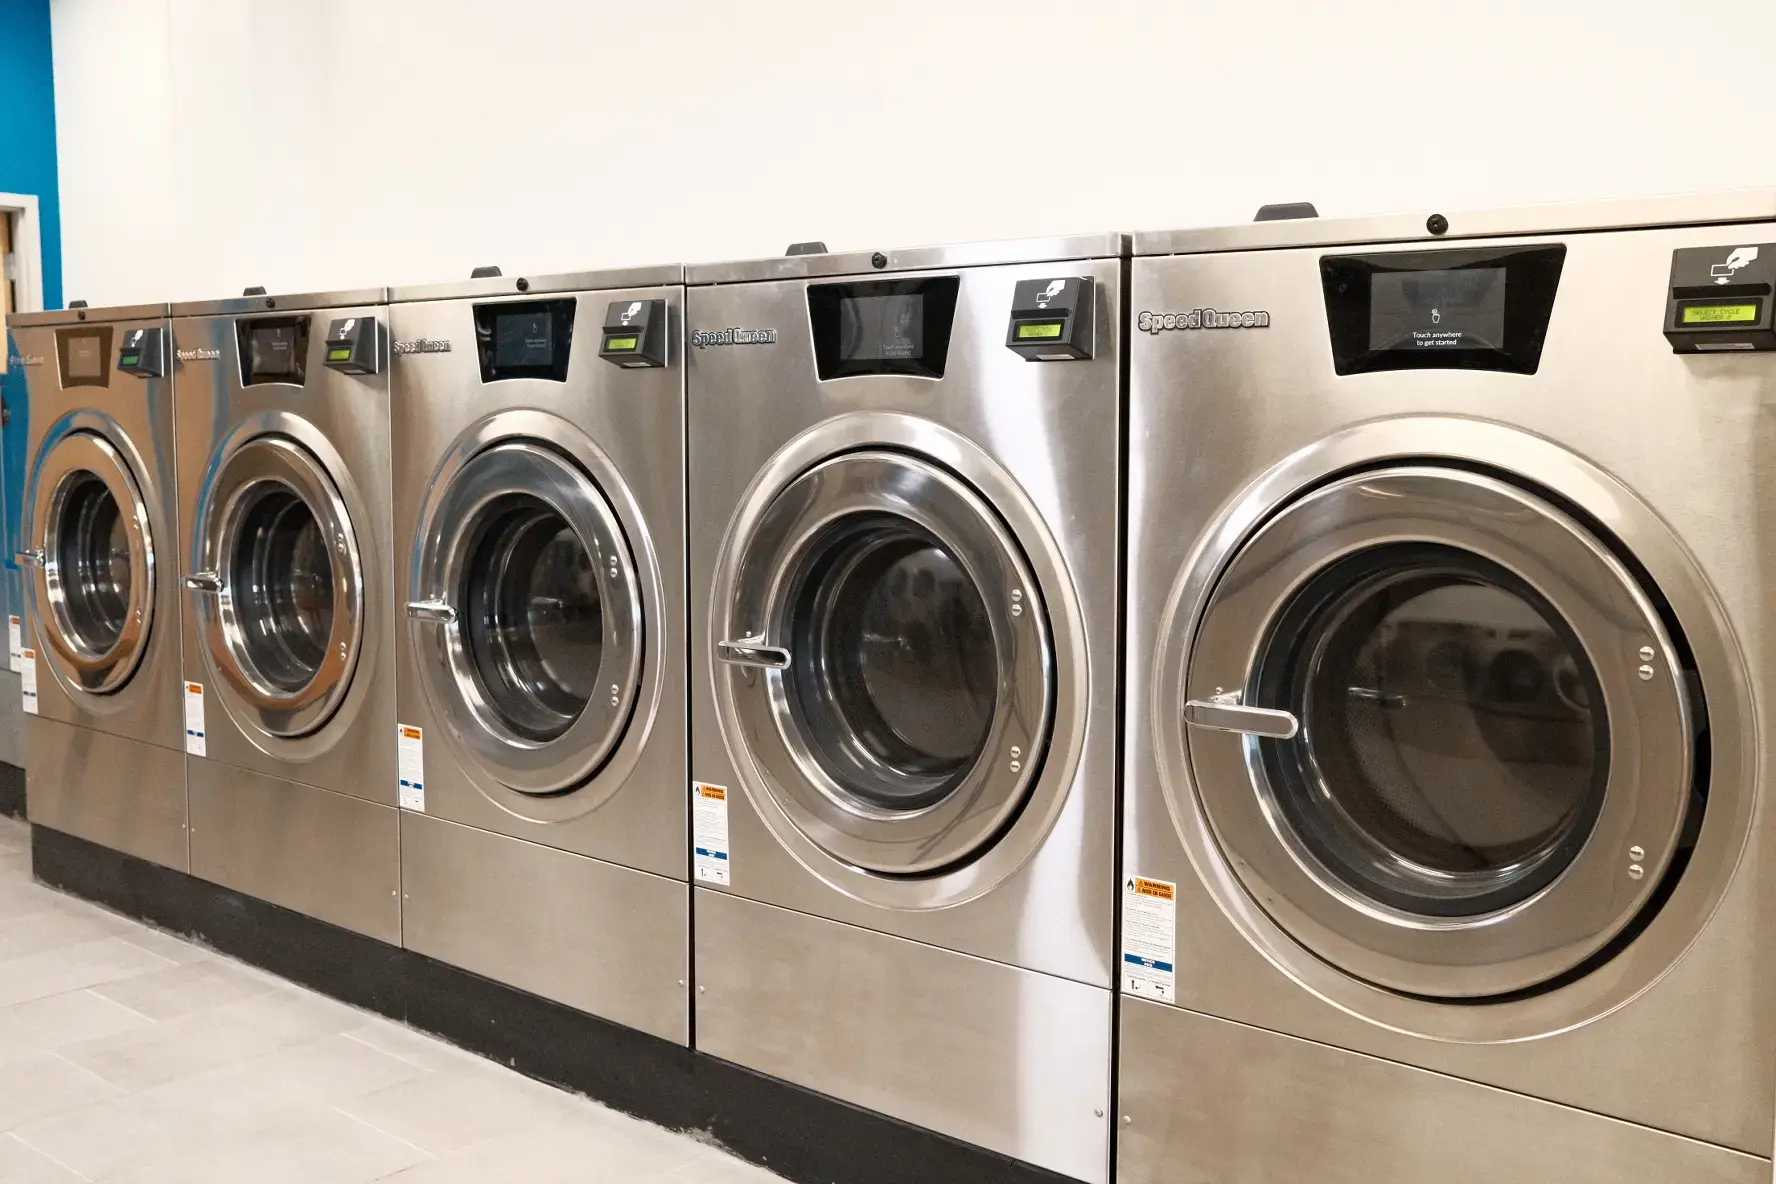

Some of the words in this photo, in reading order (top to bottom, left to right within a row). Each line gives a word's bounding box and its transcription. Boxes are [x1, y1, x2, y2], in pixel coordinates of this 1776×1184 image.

[1138, 309, 1202, 335] Speed
[1202, 308, 1270, 329] Queen
[692, 328, 733, 349] Speed
[733, 327, 777, 344] Queen
[1412, 331, 1431, 339] Touch
[1432, 331, 1462, 339] anywhere
[1143, 880, 1171, 892] WARNING
